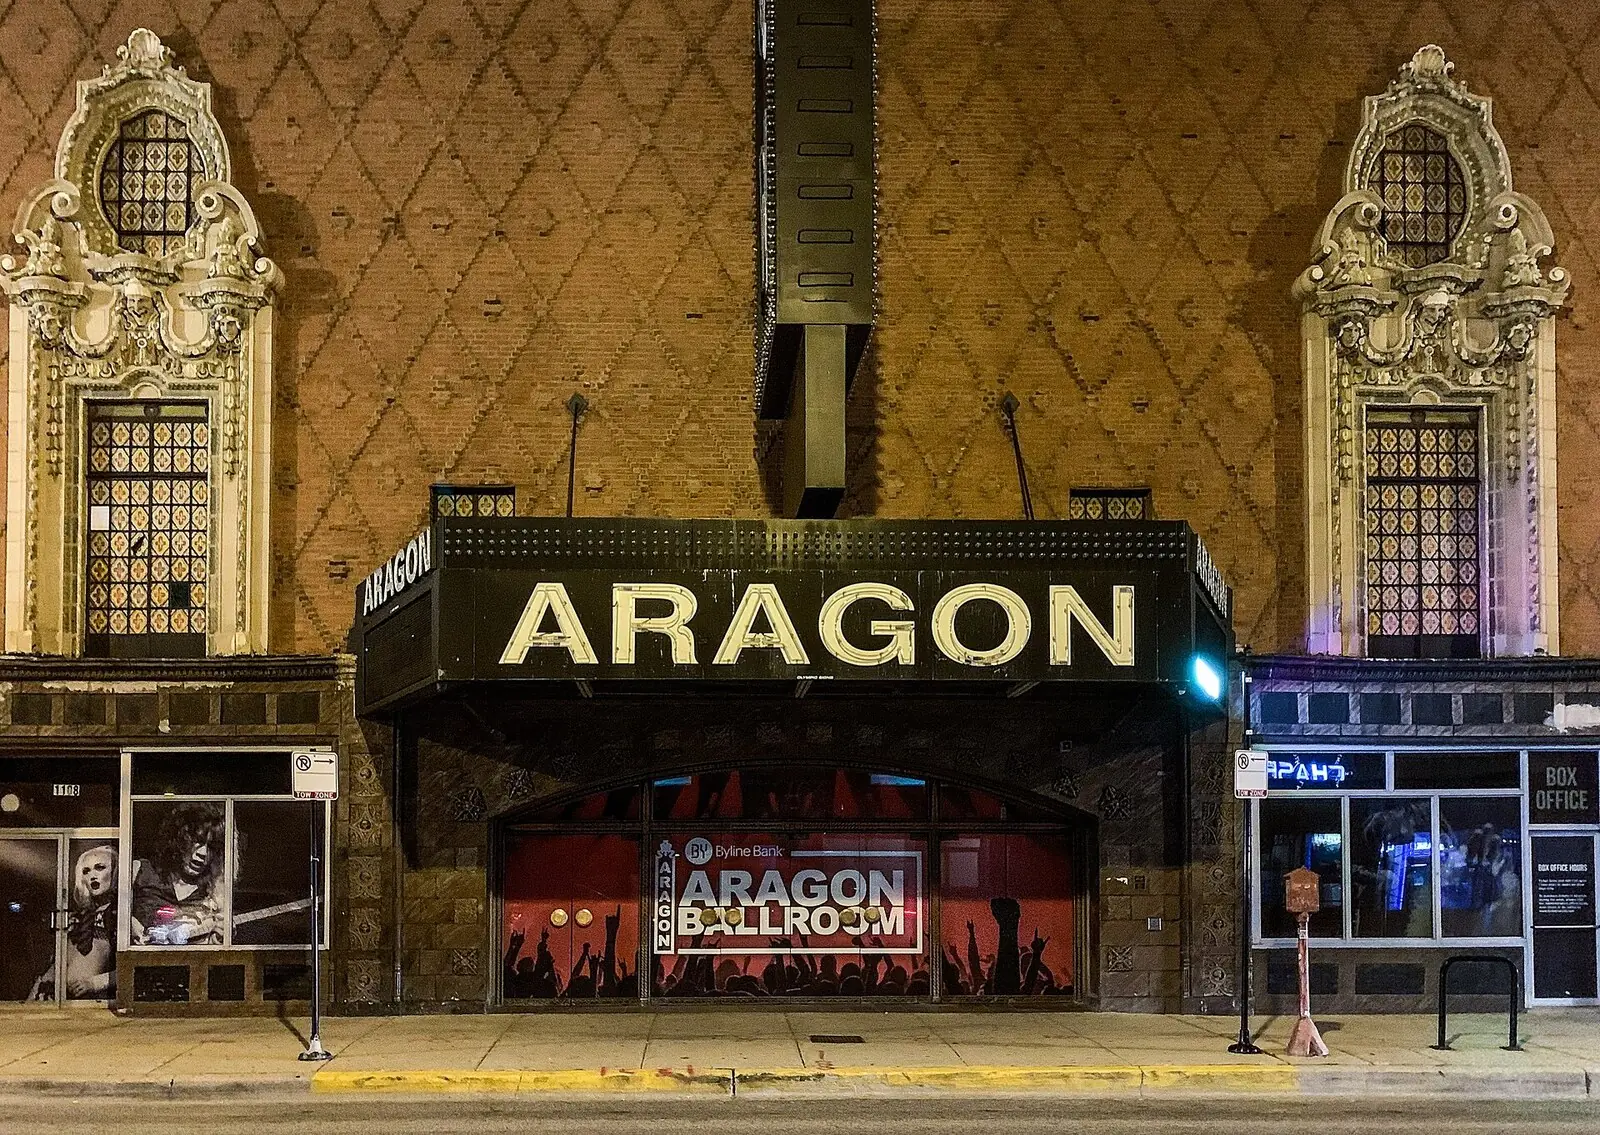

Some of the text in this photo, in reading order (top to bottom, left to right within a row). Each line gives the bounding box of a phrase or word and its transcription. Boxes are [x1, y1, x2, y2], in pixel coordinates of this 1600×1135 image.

[363, 526, 430, 616] ARAGON
[498, 582, 1135, 667] ARAGON
[1546, 766, 1577, 787] BOX
[1536, 790, 1589, 810] OFFICE
[691, 843, 783, 860] BY Byline Bank
[1538, 863, 1588, 872] BOX OFFICE HOURS
[678, 869, 904, 907] ARAGON
[658, 861, 672, 948] ARAGON
[677, 906, 905, 936] BALLROOM
